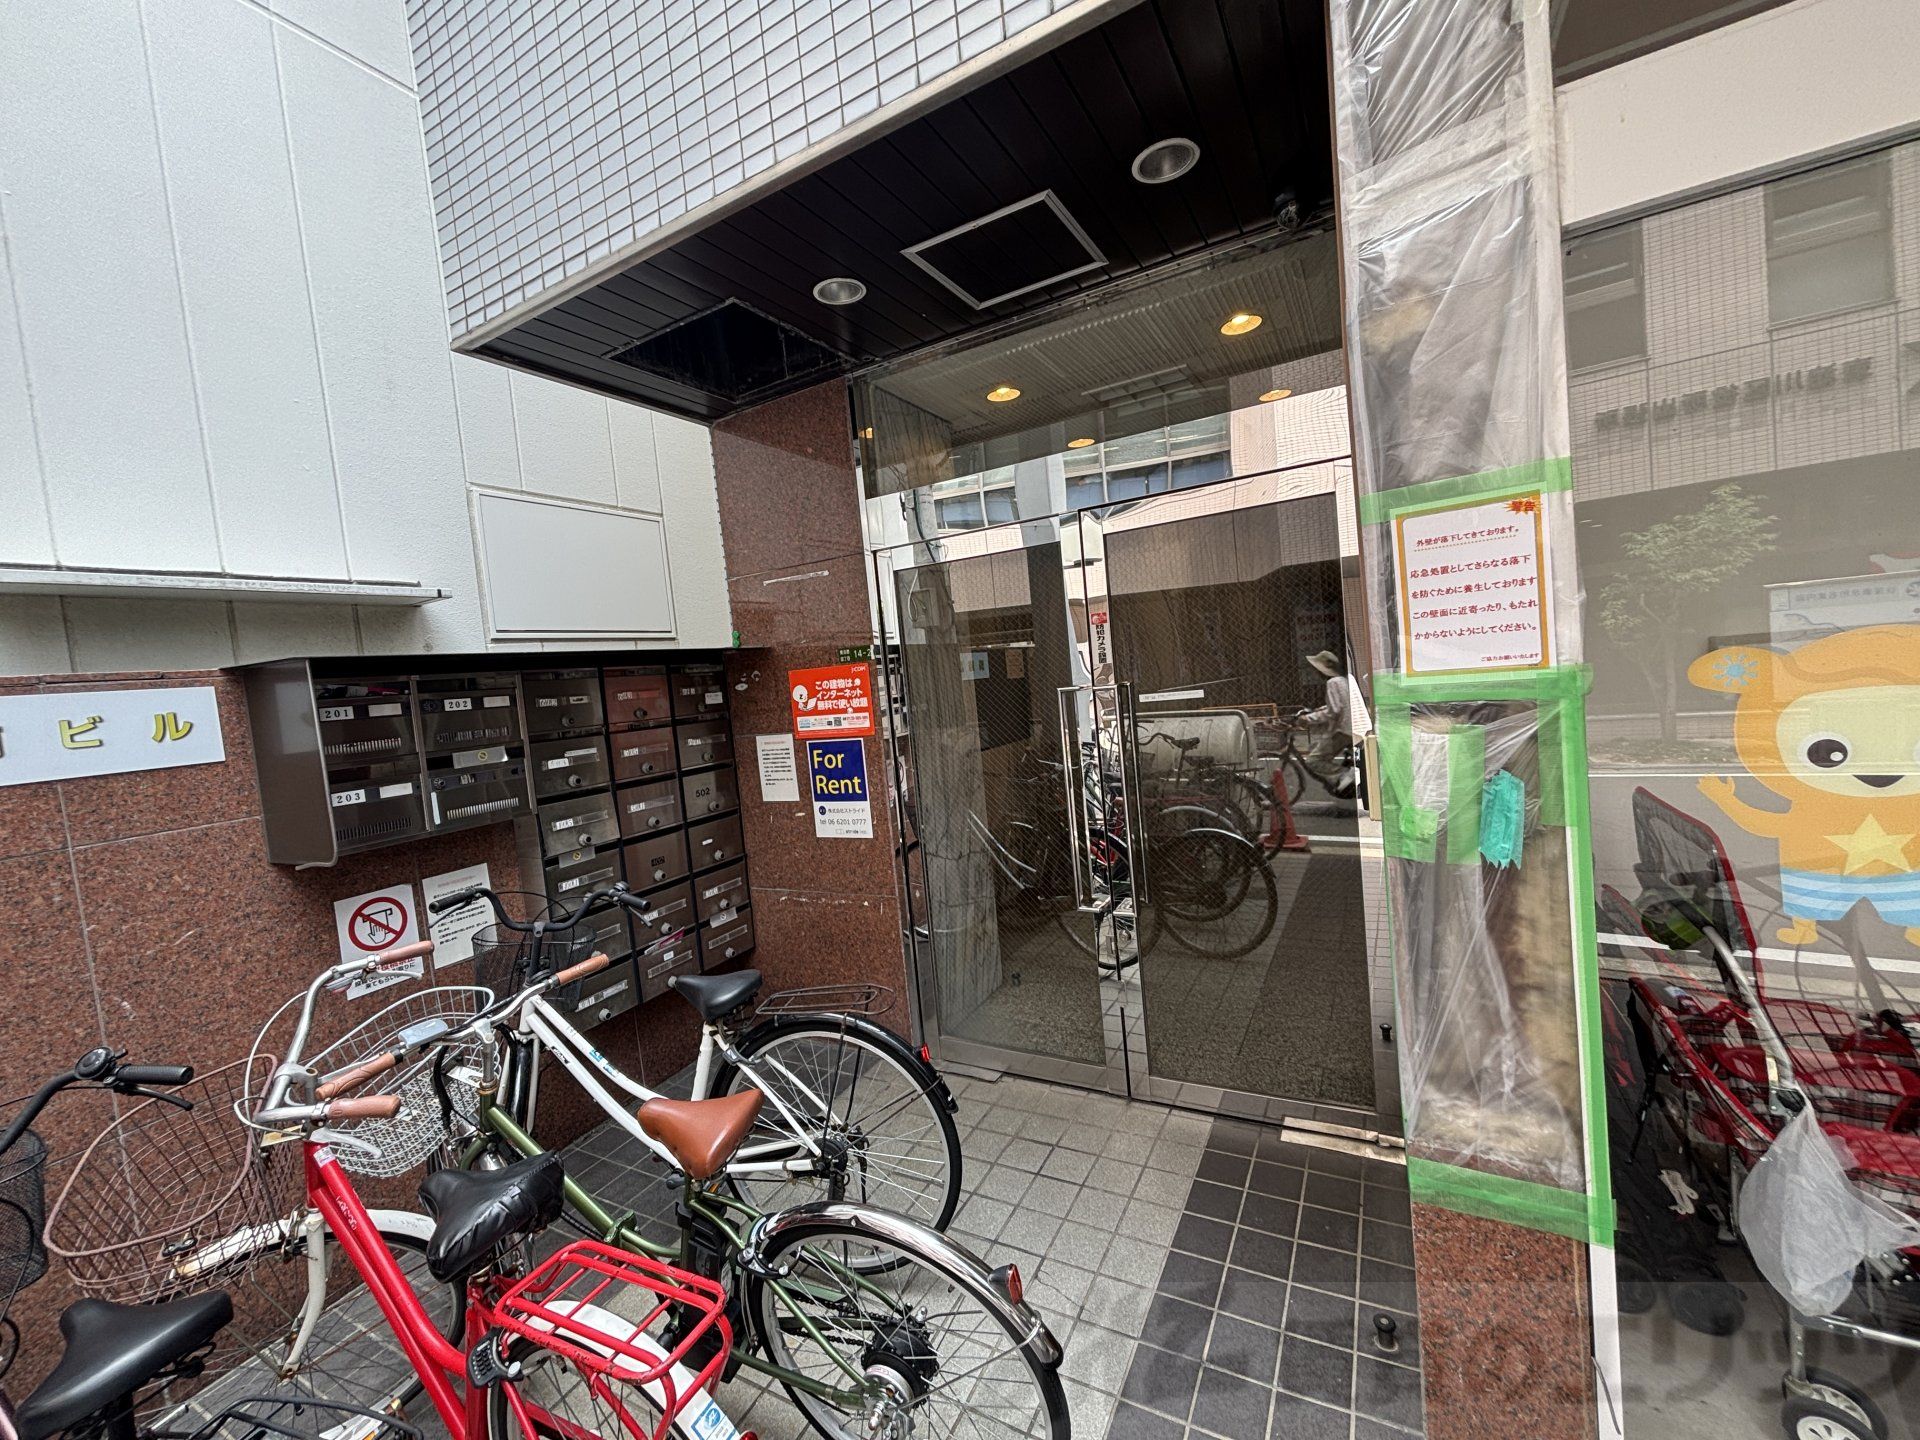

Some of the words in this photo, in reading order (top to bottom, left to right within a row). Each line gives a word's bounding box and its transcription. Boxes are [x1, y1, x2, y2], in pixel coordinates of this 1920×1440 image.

[1416, 525, 1520, 547] 外壁が落下してきております。
[1410, 554, 1531, 578] 応急処置としてさらなる落下
[1411, 576, 1538, 599] を防ぐために養生しております
[1412, 599, 1539, 620] この壁面に近寄ったり、もたれ
[1414, 622, 1538, 640] かからないようにしてください。
[815, 678, 853, 691] この建物は
[816, 688, 863, 700] インターネット
[448, 700, 468, 709] 202
[817, 697, 869, 711] 無料で使い放題
[325, 709, 349, 719] 201
[812, 749, 845, 769] For
[815, 775, 863, 794] Rent
[336, 792, 361, 804] 203
